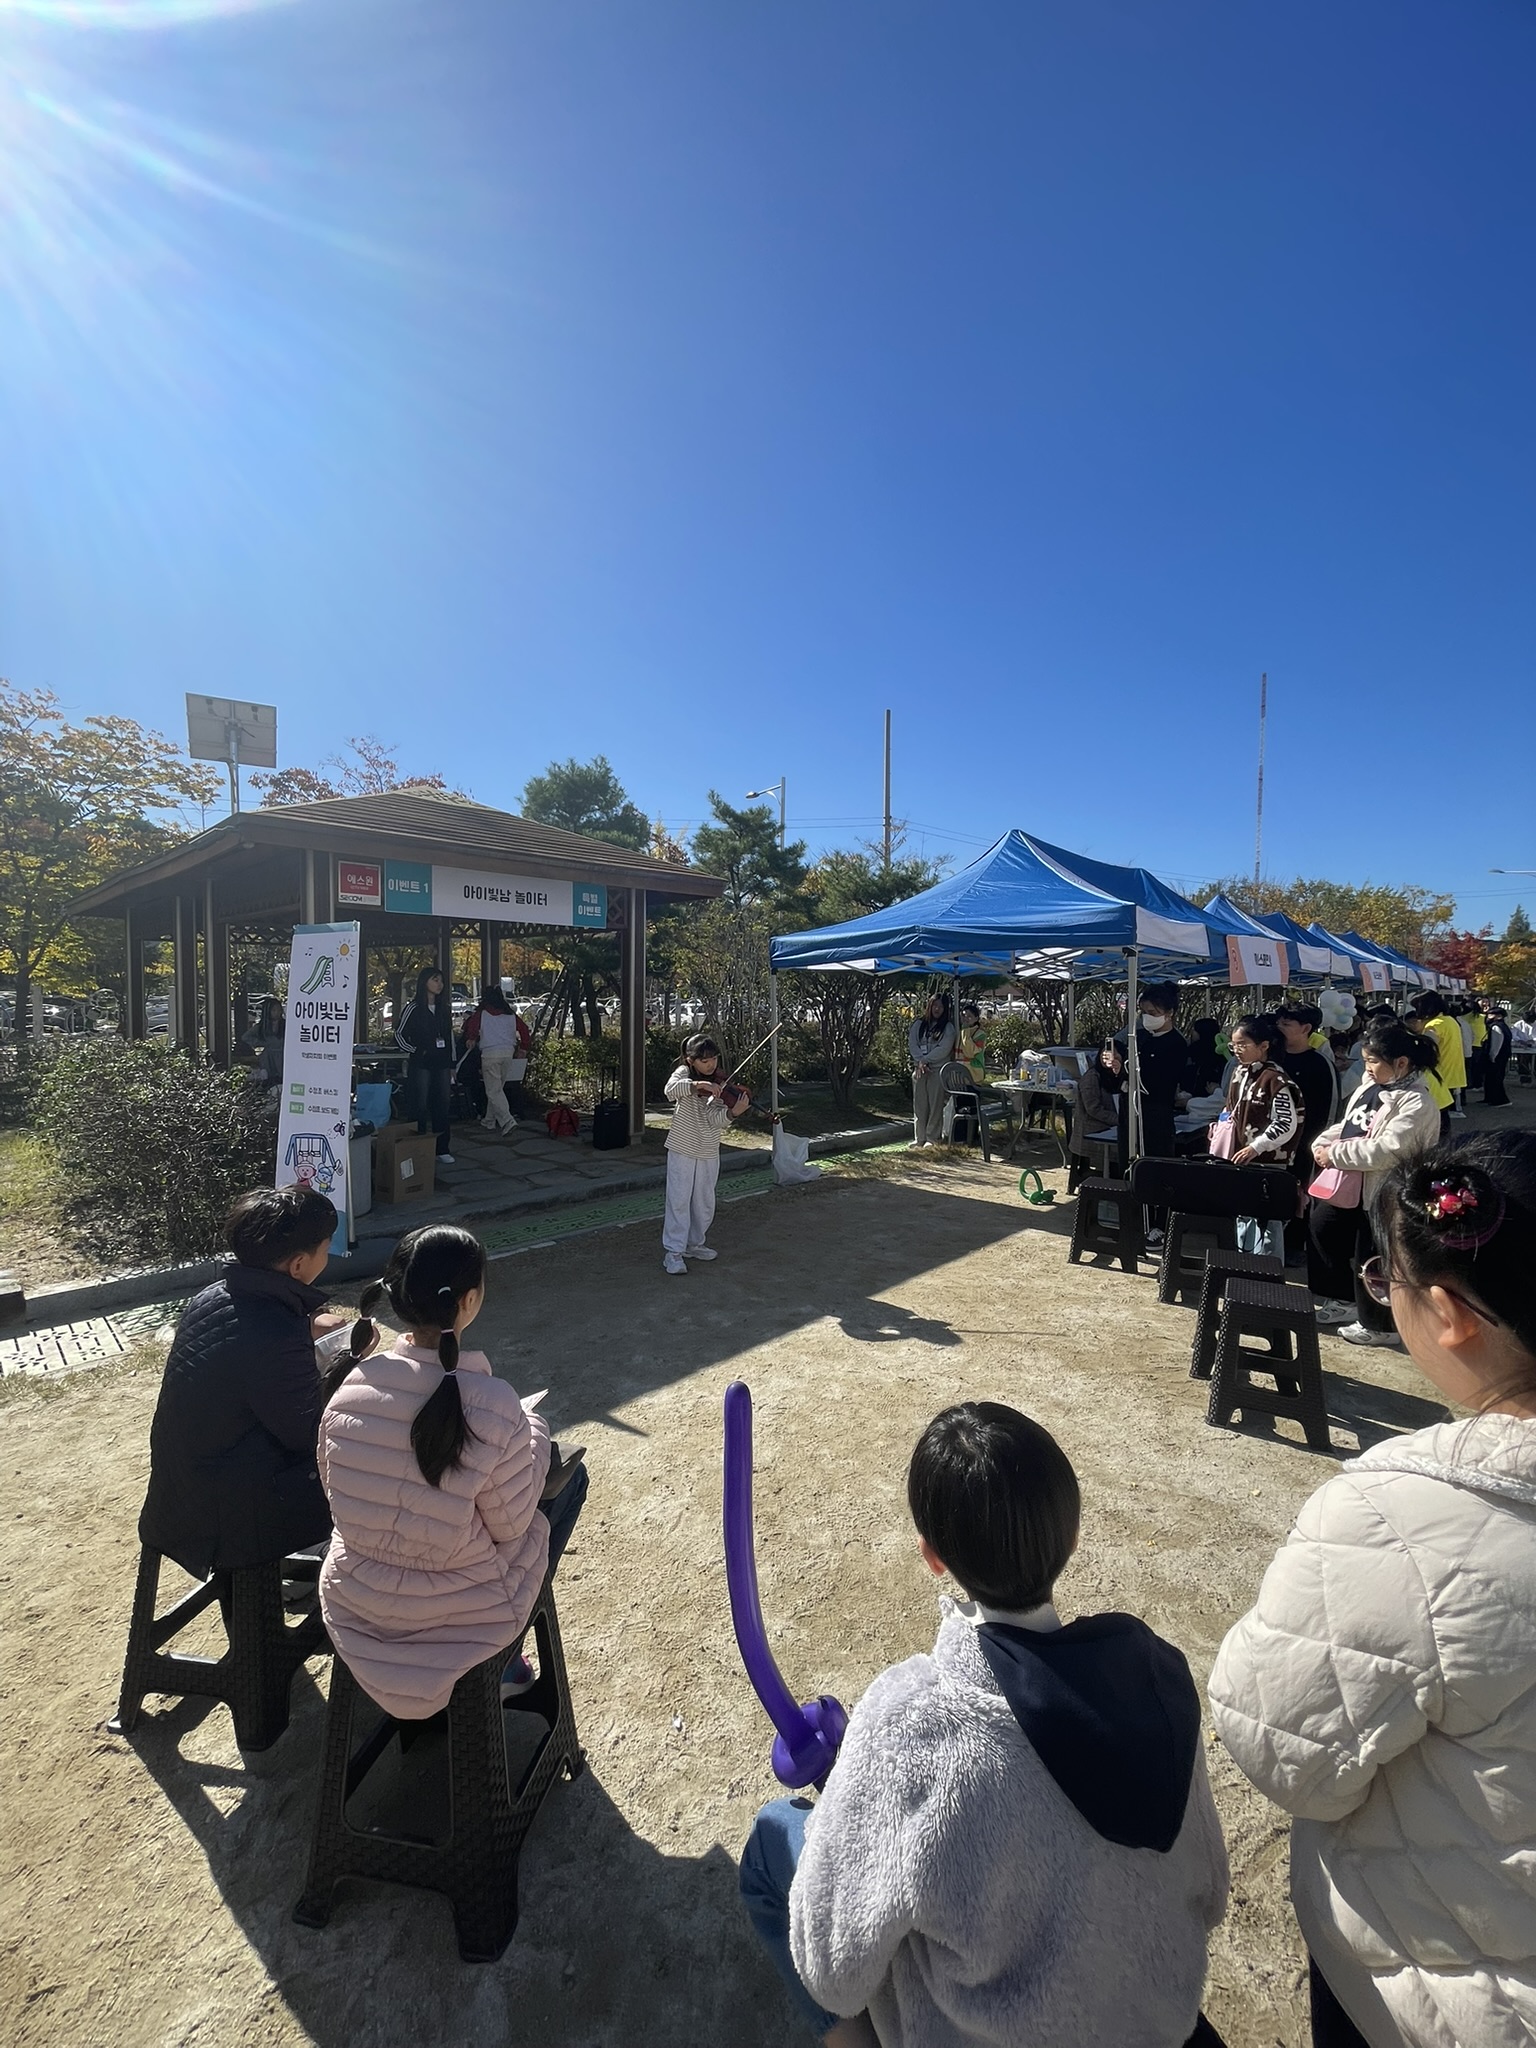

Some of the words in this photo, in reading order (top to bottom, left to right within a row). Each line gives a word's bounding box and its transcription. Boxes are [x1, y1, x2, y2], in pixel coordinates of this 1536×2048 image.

[347, 874, 373, 887] 에스원
[388, 878, 421, 893] 이벤트
[423, 882, 429, 893] 1
[340, 894, 362, 902] SECOM
[463, 885, 512, 903] 아이빛남
[515, 890, 548, 906] 놀이터
[578, 905, 602, 917] 이벤트
[295, 1001, 350, 1020] 아이빛남
[300, 1024, 340, 1044] 놀이터
[1265, 1092, 1292, 1142] BROOKLYN
